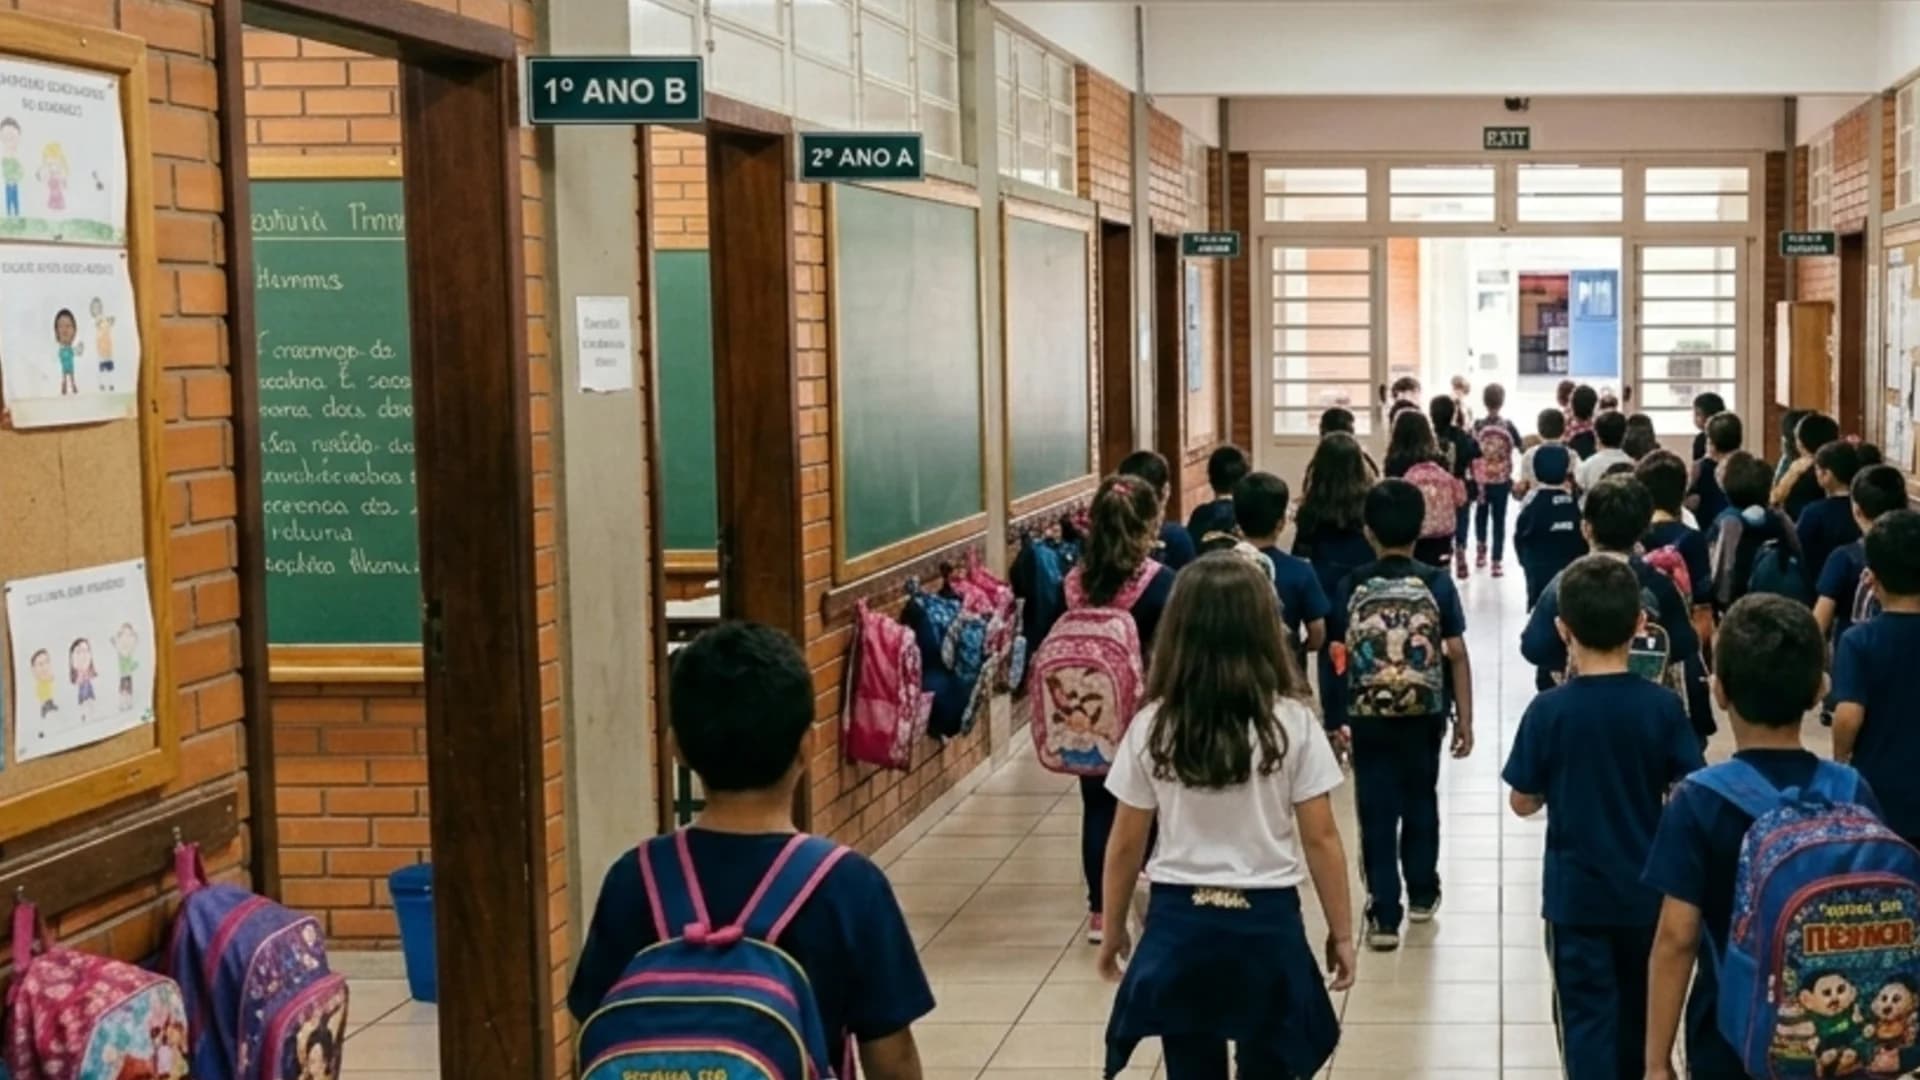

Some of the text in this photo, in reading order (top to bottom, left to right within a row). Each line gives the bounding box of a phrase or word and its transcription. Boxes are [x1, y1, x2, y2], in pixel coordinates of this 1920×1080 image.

[544, 77, 688, 104] 1º ANO B
[838, 147, 891, 167] ANO
[895, 147, 915, 167] A
